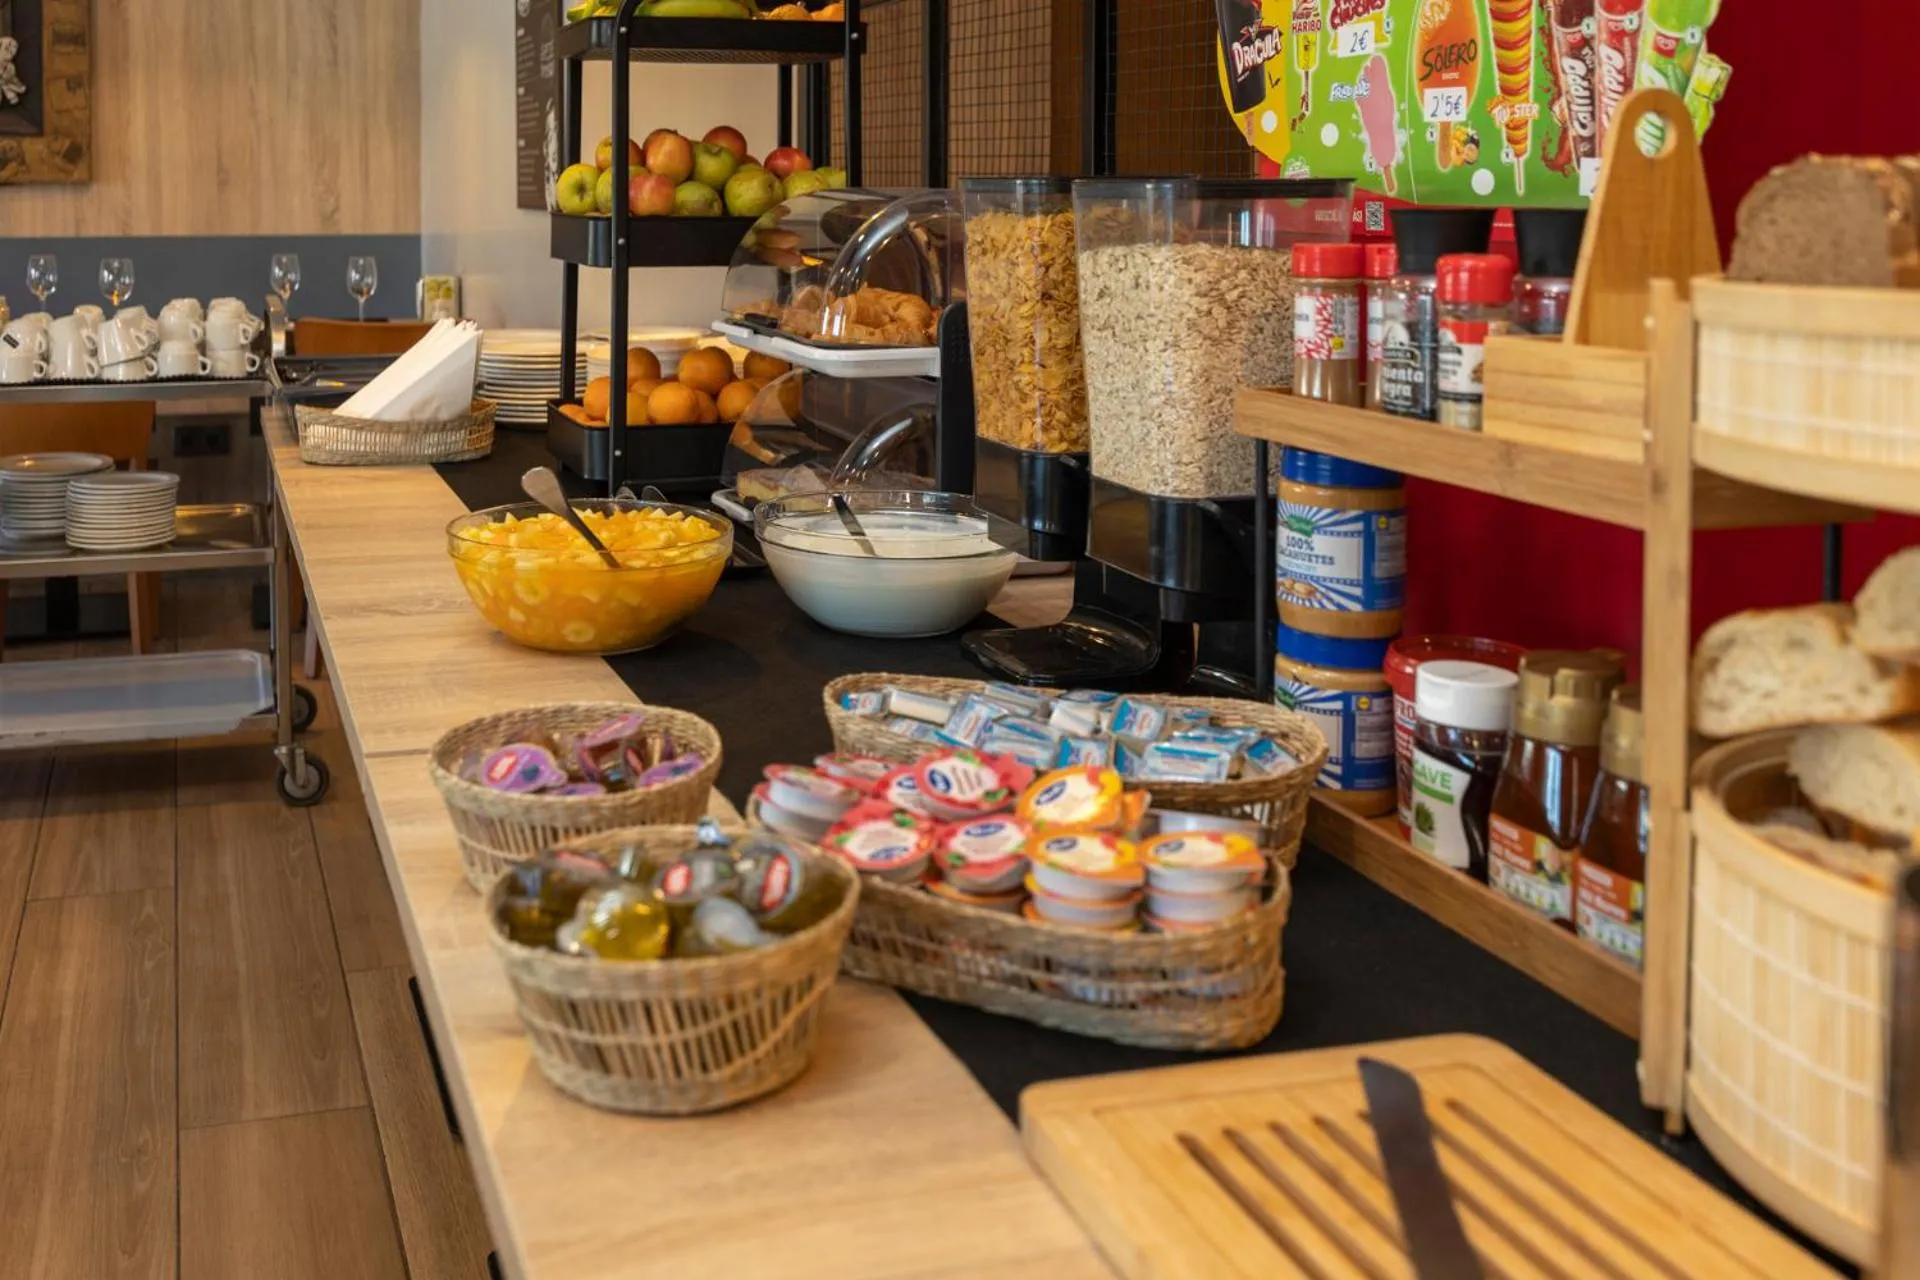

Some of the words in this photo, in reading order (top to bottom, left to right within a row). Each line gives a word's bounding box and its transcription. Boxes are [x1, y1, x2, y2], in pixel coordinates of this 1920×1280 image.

[1292, 19, 1322, 33] HARIBO
[1232, 28, 1281, 76] DRACULA
[1350, 29, 1369, 53] 2€
[1419, 39, 1477, 81] SOLERO
[1287, 532, 1316, 551] 100%
